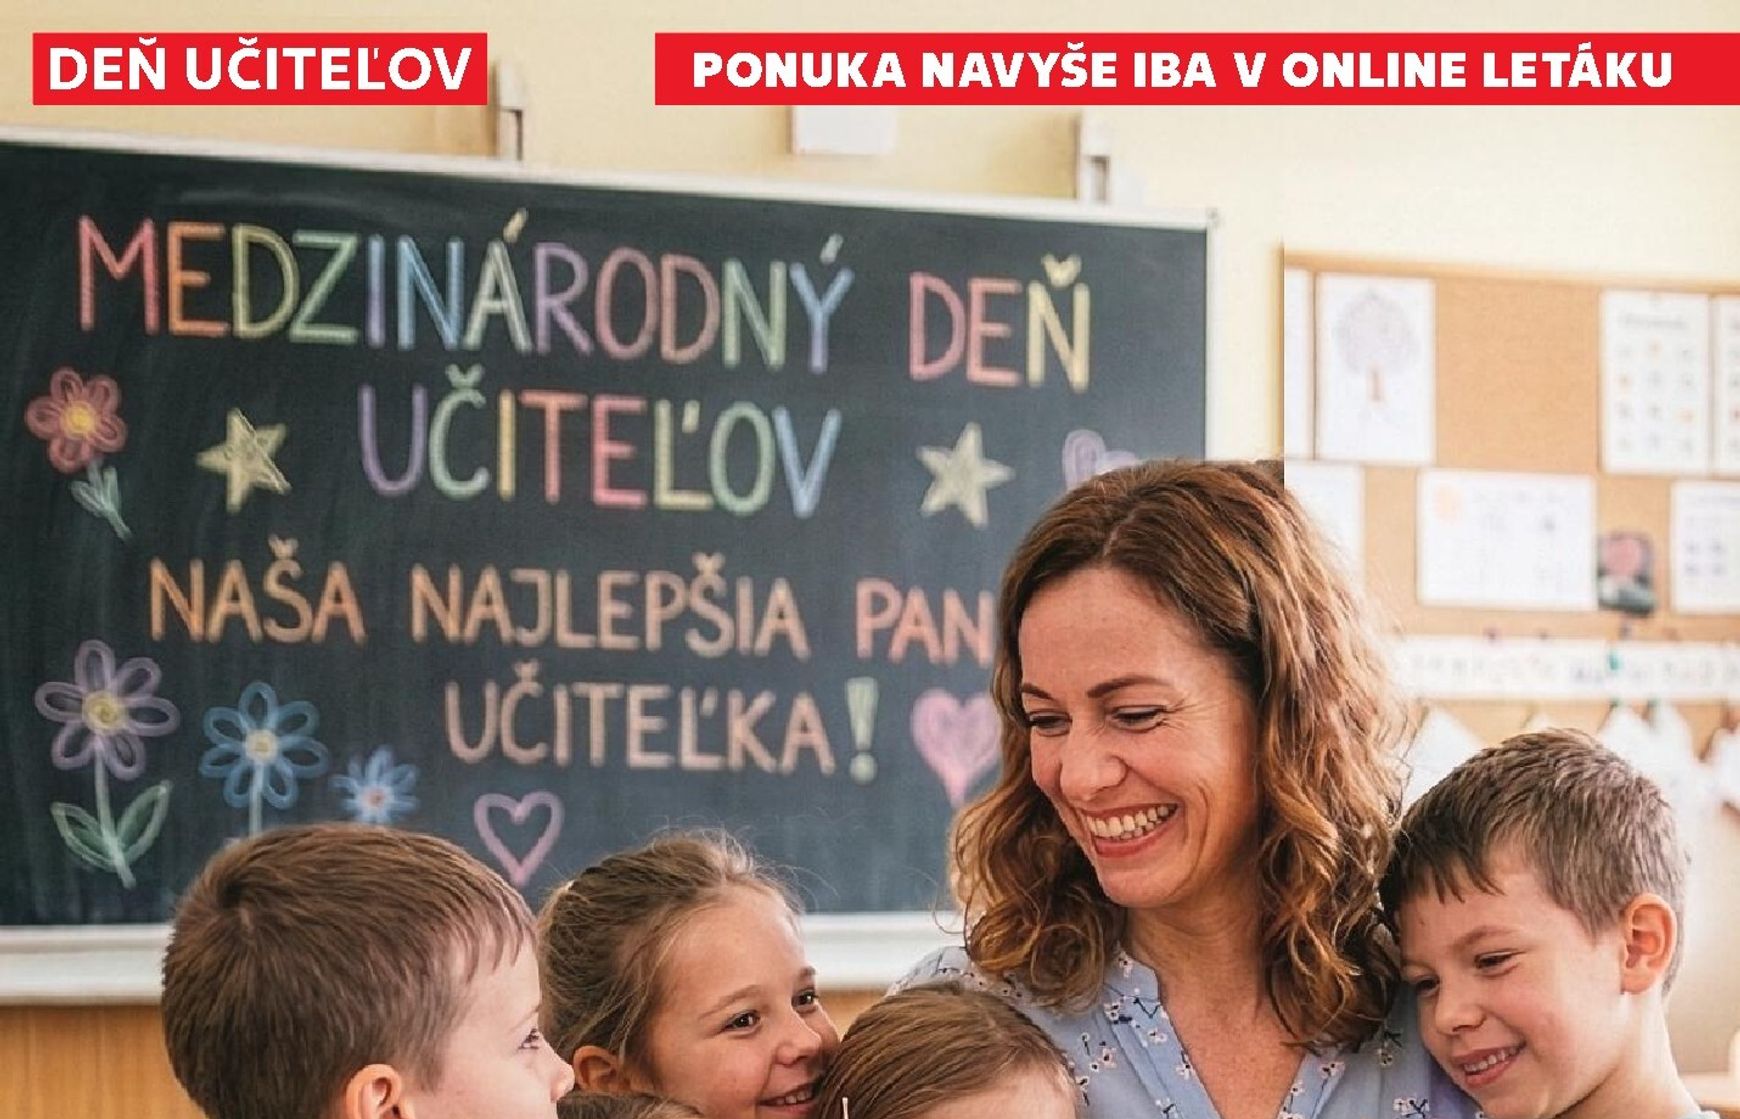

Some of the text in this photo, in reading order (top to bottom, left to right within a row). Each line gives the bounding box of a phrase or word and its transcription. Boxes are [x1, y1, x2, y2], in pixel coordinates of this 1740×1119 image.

[77, 209, 1091, 390] MEDZINÁRODNÝ DEŇ
[358, 364, 841, 518] UČITEĽOV
[149, 535, 365, 645] NAŠA
[410, 552, 811, 659] NAJLEPŠIA
